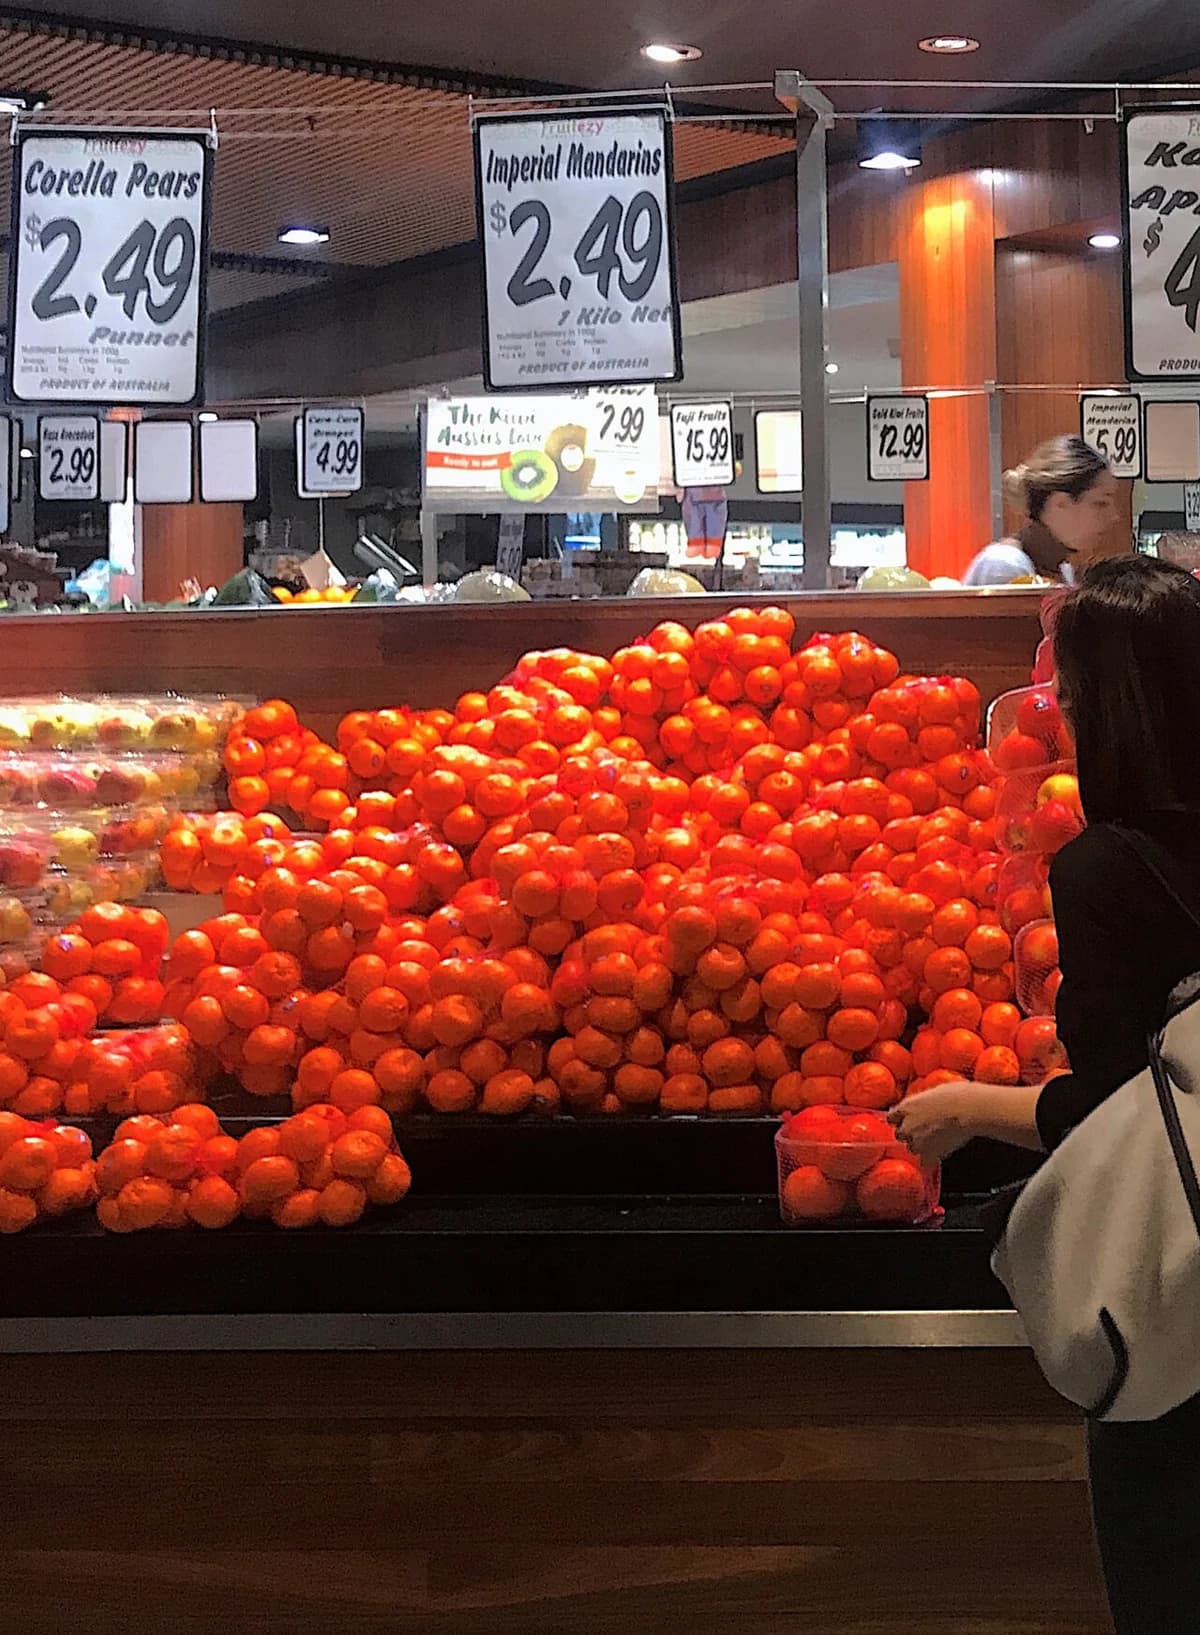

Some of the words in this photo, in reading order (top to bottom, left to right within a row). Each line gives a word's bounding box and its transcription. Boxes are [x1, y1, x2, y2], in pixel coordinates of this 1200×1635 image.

[540, 119, 604, 137] Fruitezy
[486, 143, 562, 192] Imperial
[566, 139, 662, 181] Mandarins
[25, 158, 117, 198] Corella
[125, 161, 201, 199] Pears
[557, 310, 570, 326] 1
[576, 306, 622, 326] Kilo
[630, 305, 672, 323] Net
[88, 326, 194, 347] Punnet
[518, 361, 570, 375] PRODUCT
[571, 360, 584, 371] OF
[588, 357, 649, 370] AUSTRALIA
[39, 377, 91, 390] PRODUCT
[92, 379, 106, 390] OF
[108, 379, 171, 392] AUSTRALIA
[1091, 402, 1132, 413] Imperial
[676, 411, 695, 424] Fuji
[698, 410, 727, 422] Fruits
[1086, 416, 1136, 425] Mandarins
